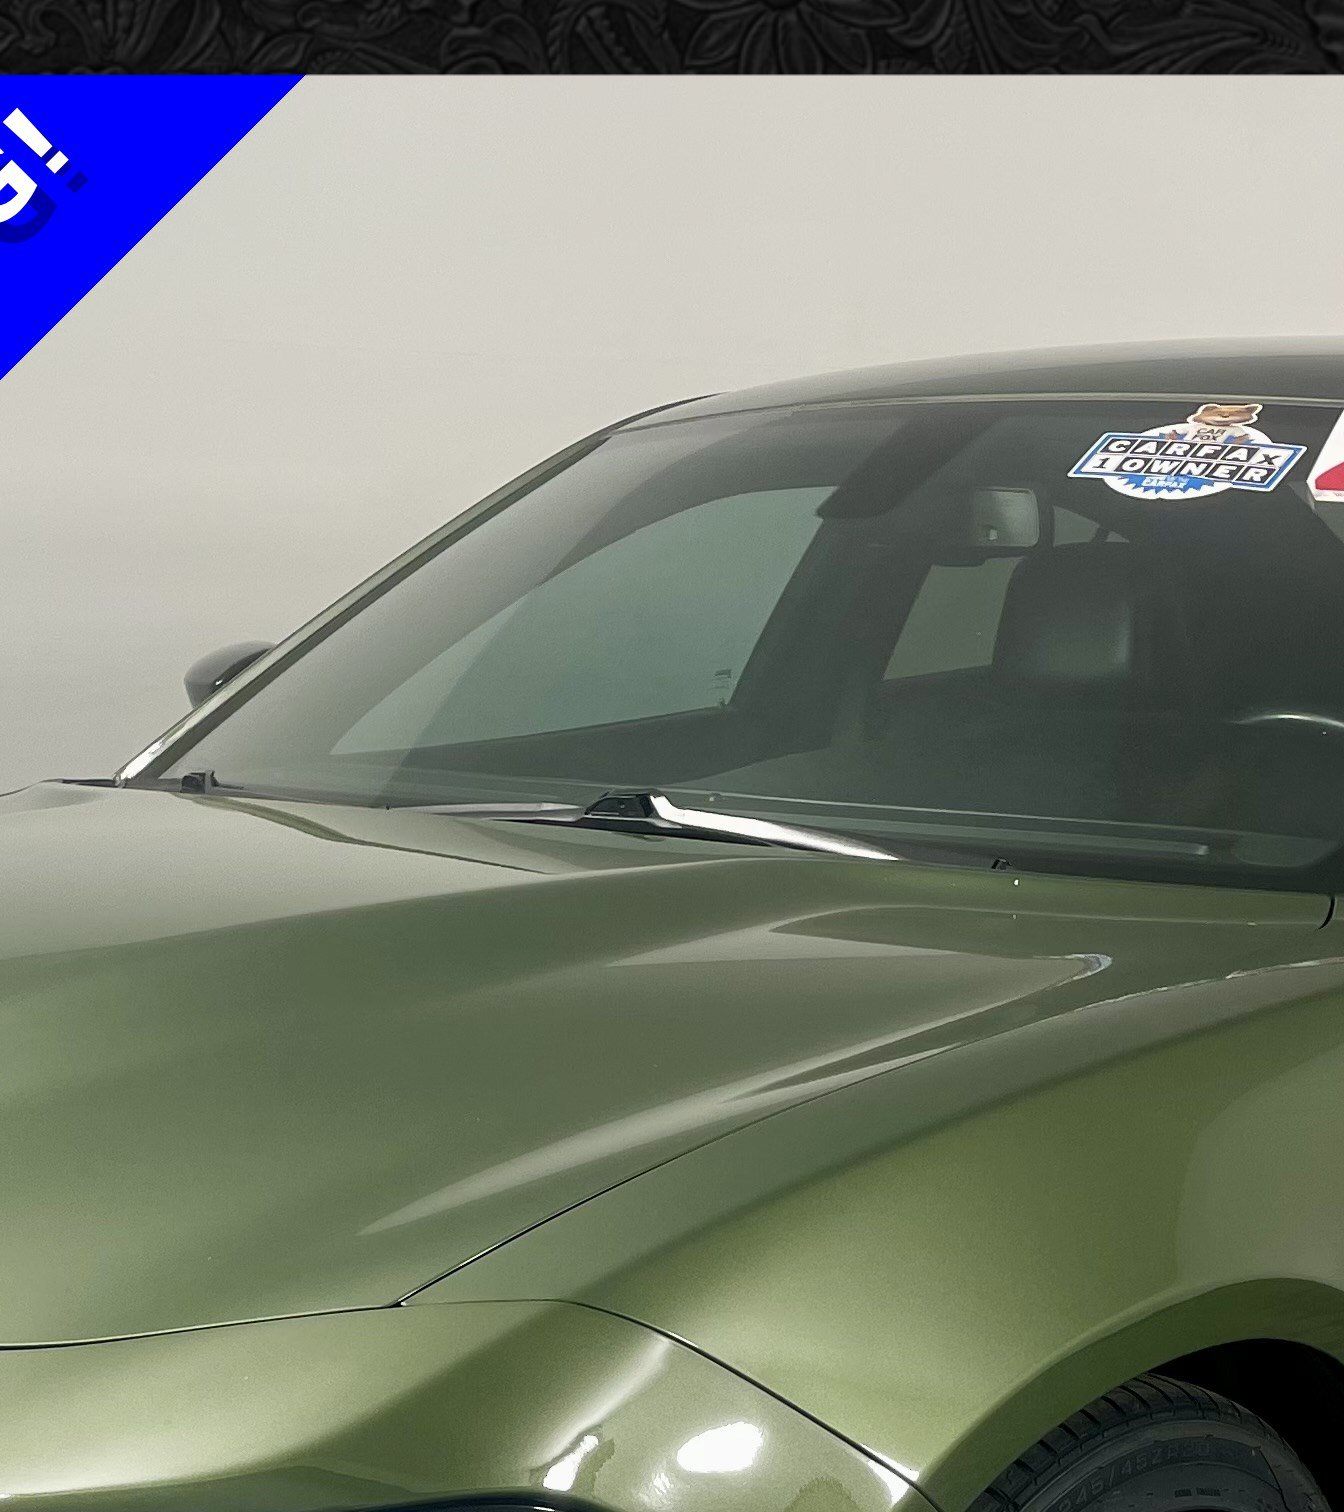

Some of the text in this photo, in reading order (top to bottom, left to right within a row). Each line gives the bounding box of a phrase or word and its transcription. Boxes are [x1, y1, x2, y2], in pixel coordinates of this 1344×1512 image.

[1107, 440, 1281, 467] CARFAX
[1092, 457, 1269, 483] 1 OWNER
